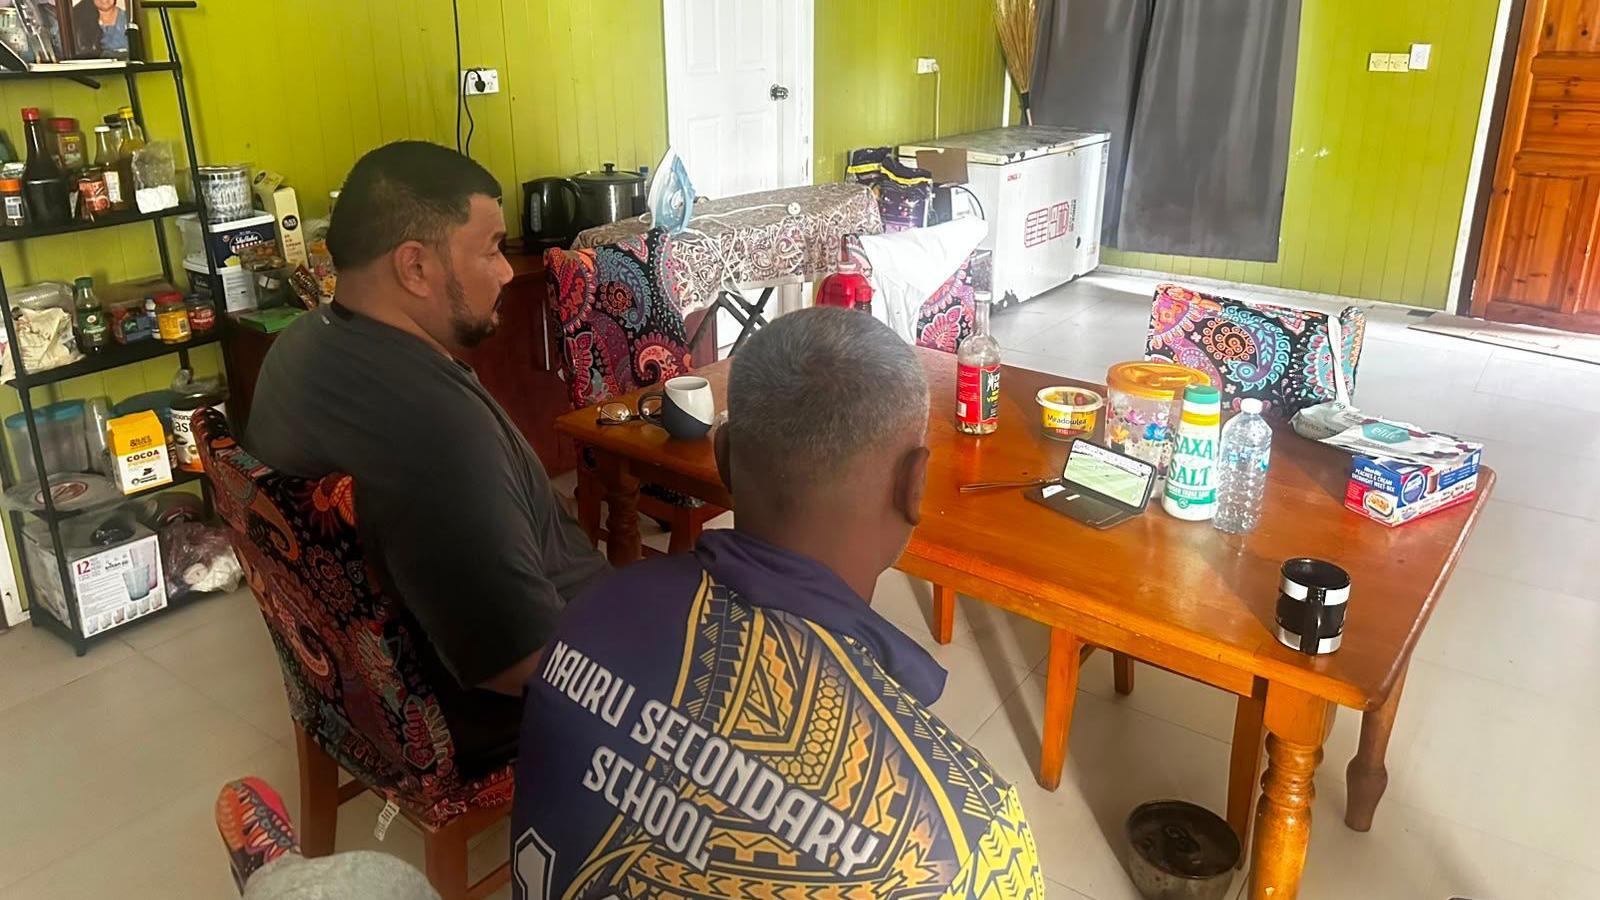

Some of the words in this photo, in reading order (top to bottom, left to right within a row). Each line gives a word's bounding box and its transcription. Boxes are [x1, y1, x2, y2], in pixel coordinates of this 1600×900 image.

[126, 449, 160, 463] COCOA
[1173, 432, 1213, 460] SAXA
[1168, 458, 1212, 486] SALT
[1377, 476, 1393, 485] CREAM
[76, 560, 91, 575] 12
[541, 640, 635, 728] NAURU
[630, 698, 880, 878] SECONDARY
[582, 744, 715, 873] SCHOOL
